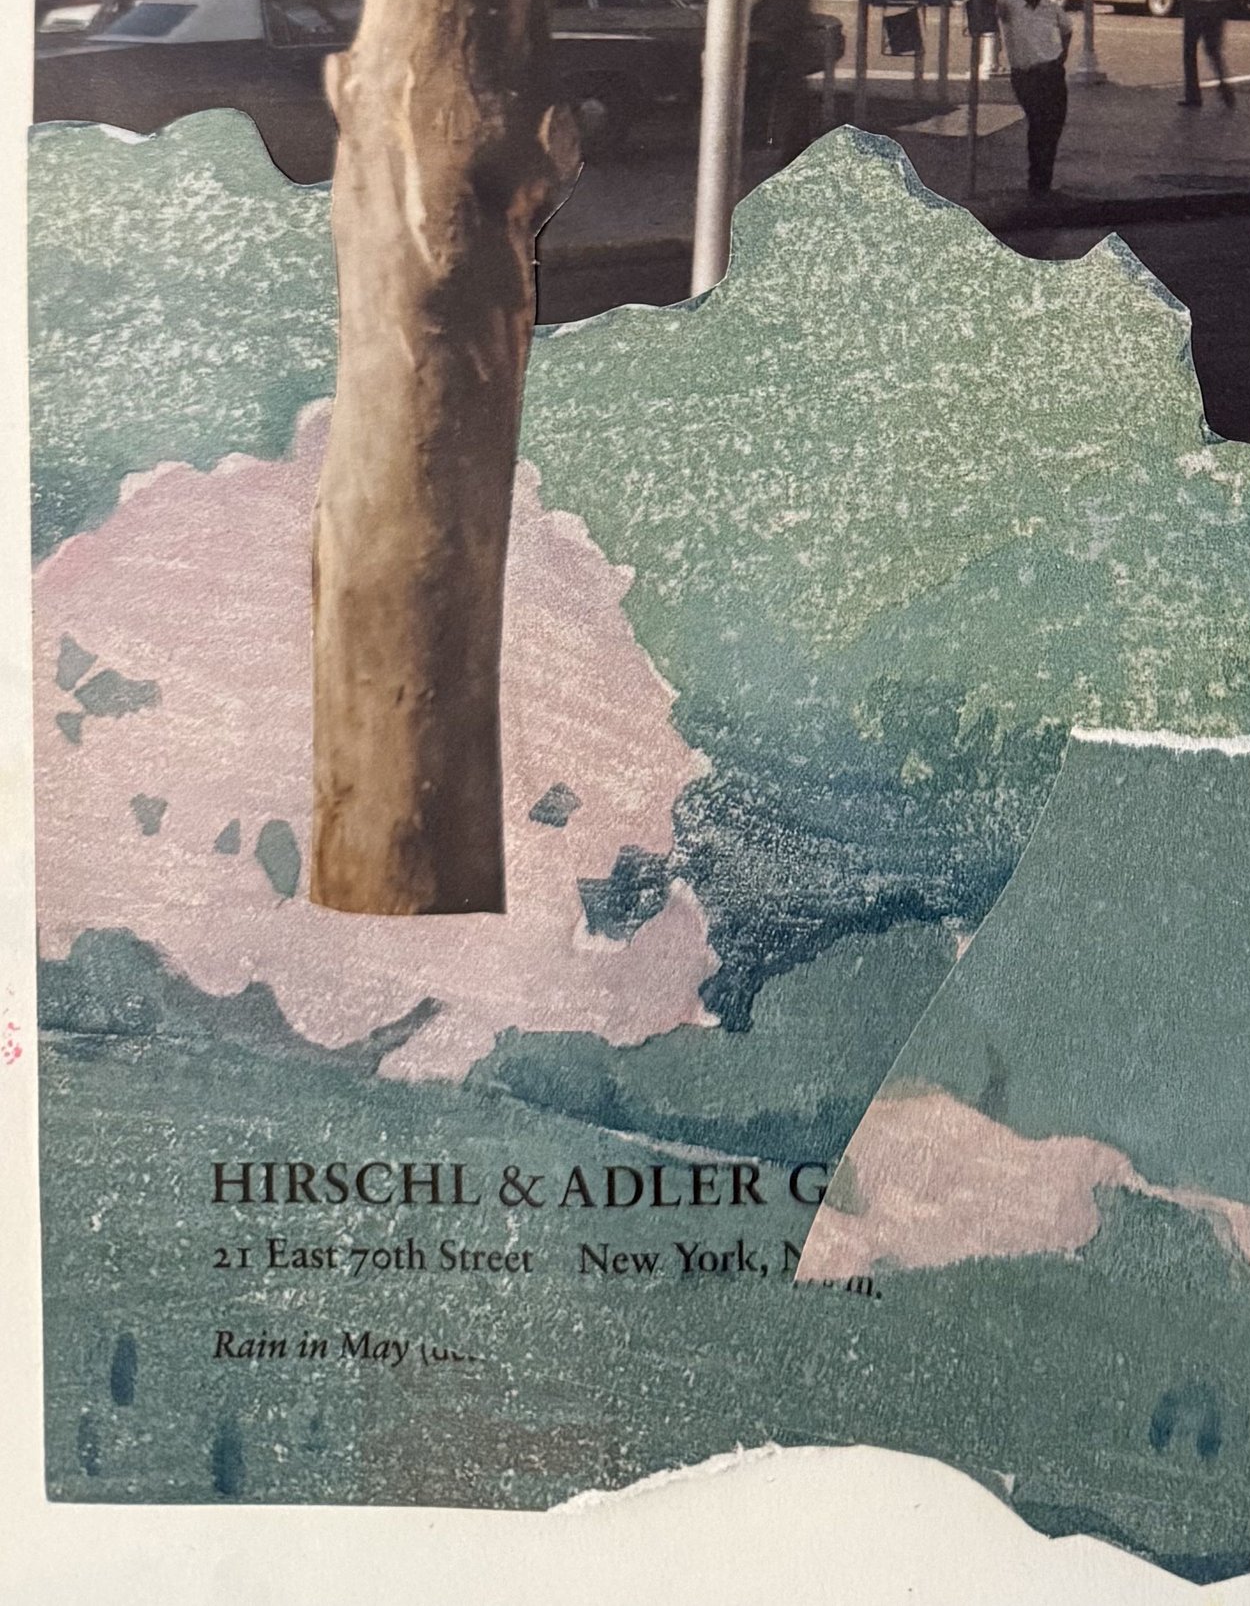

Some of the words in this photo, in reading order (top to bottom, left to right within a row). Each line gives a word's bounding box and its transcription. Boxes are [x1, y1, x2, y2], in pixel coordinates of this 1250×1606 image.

[211, 1161, 482, 1206] HIRSCHL
[498, 1164, 546, 1208] &
[558, 1161, 768, 1207] ADLER
[213, 1247, 252, 1271] 21
[266, 1239, 337, 1271] East
[350, 1239, 425, 1277] 70th
[440, 1240, 534, 1274] Street
[578, 1242, 660, 1276] New
[674, 1239, 769, 1279] York,
[212, 1329, 288, 1360] Rain
[299, 1329, 329, 1360] in
[341, 1329, 410, 1368] May
